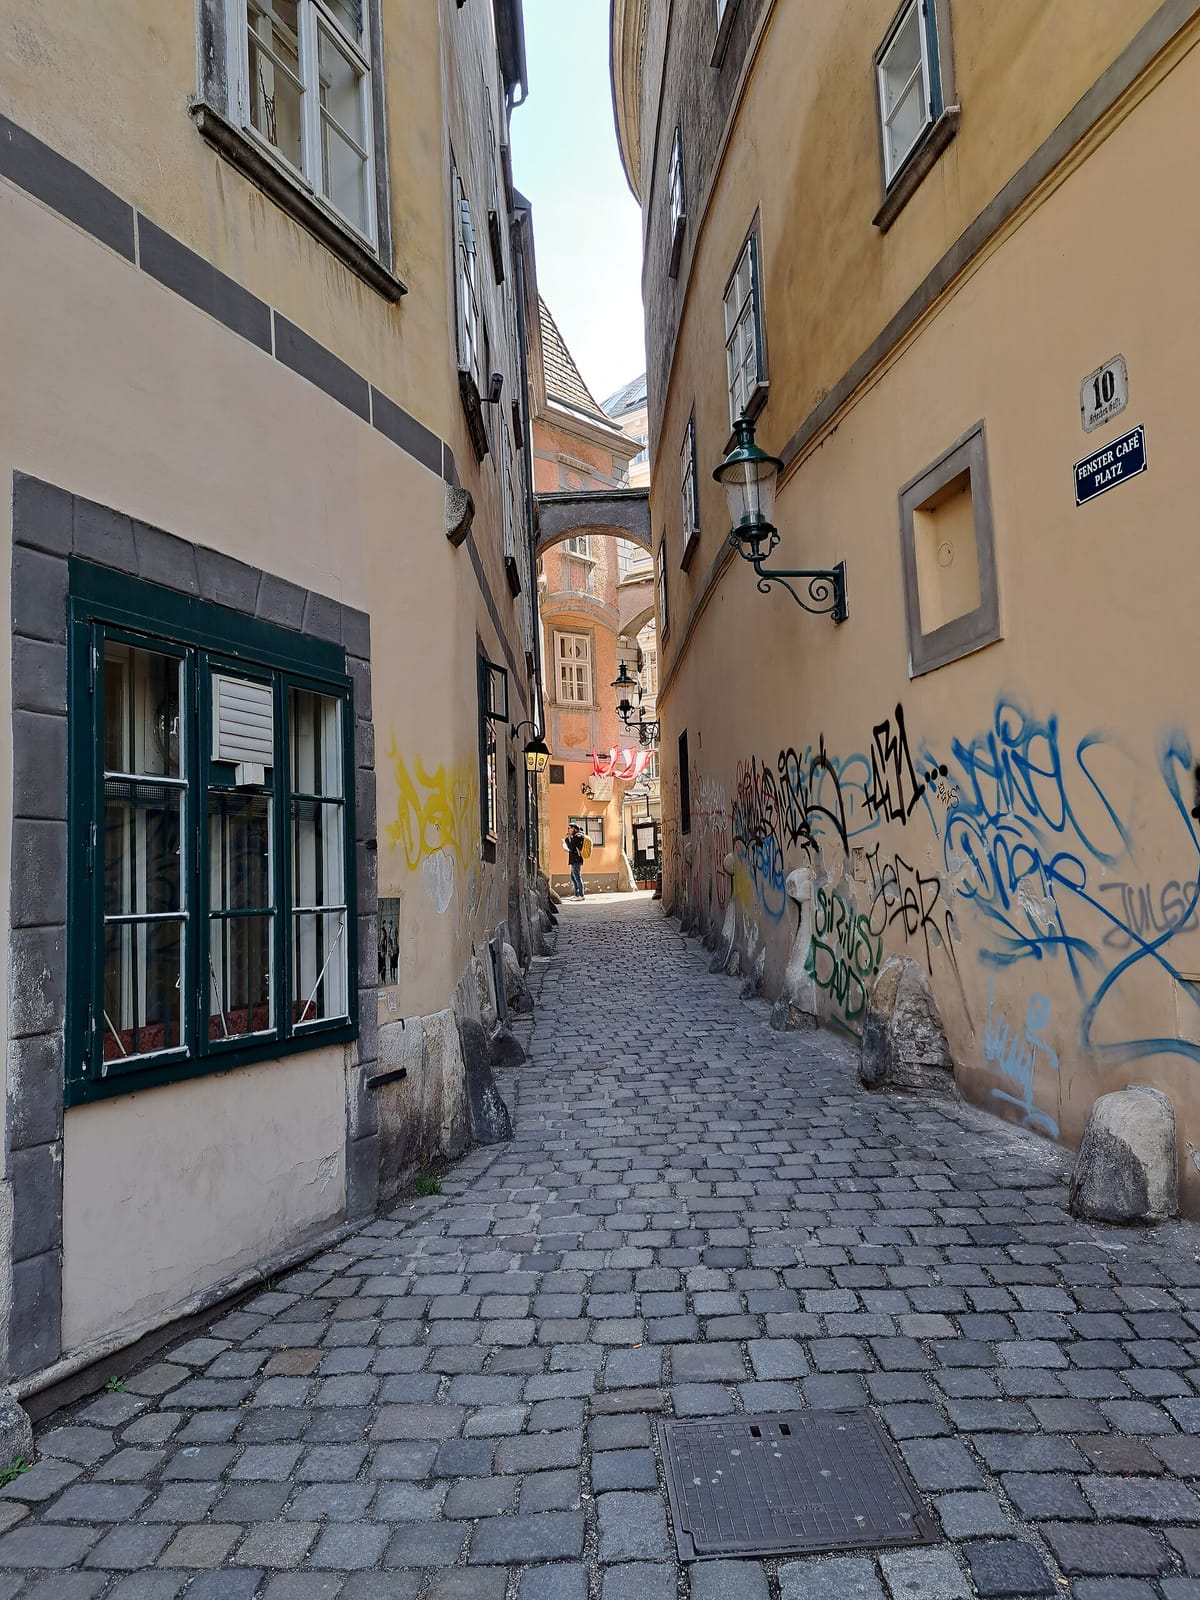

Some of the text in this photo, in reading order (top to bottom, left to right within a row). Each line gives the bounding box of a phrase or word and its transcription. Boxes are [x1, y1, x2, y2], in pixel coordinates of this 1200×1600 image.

[1093, 370, 1115, 411] 10
[1078, 432, 1140, 480] FENSTER CAFÉ
[1094, 461, 1123, 487] PLATZ
